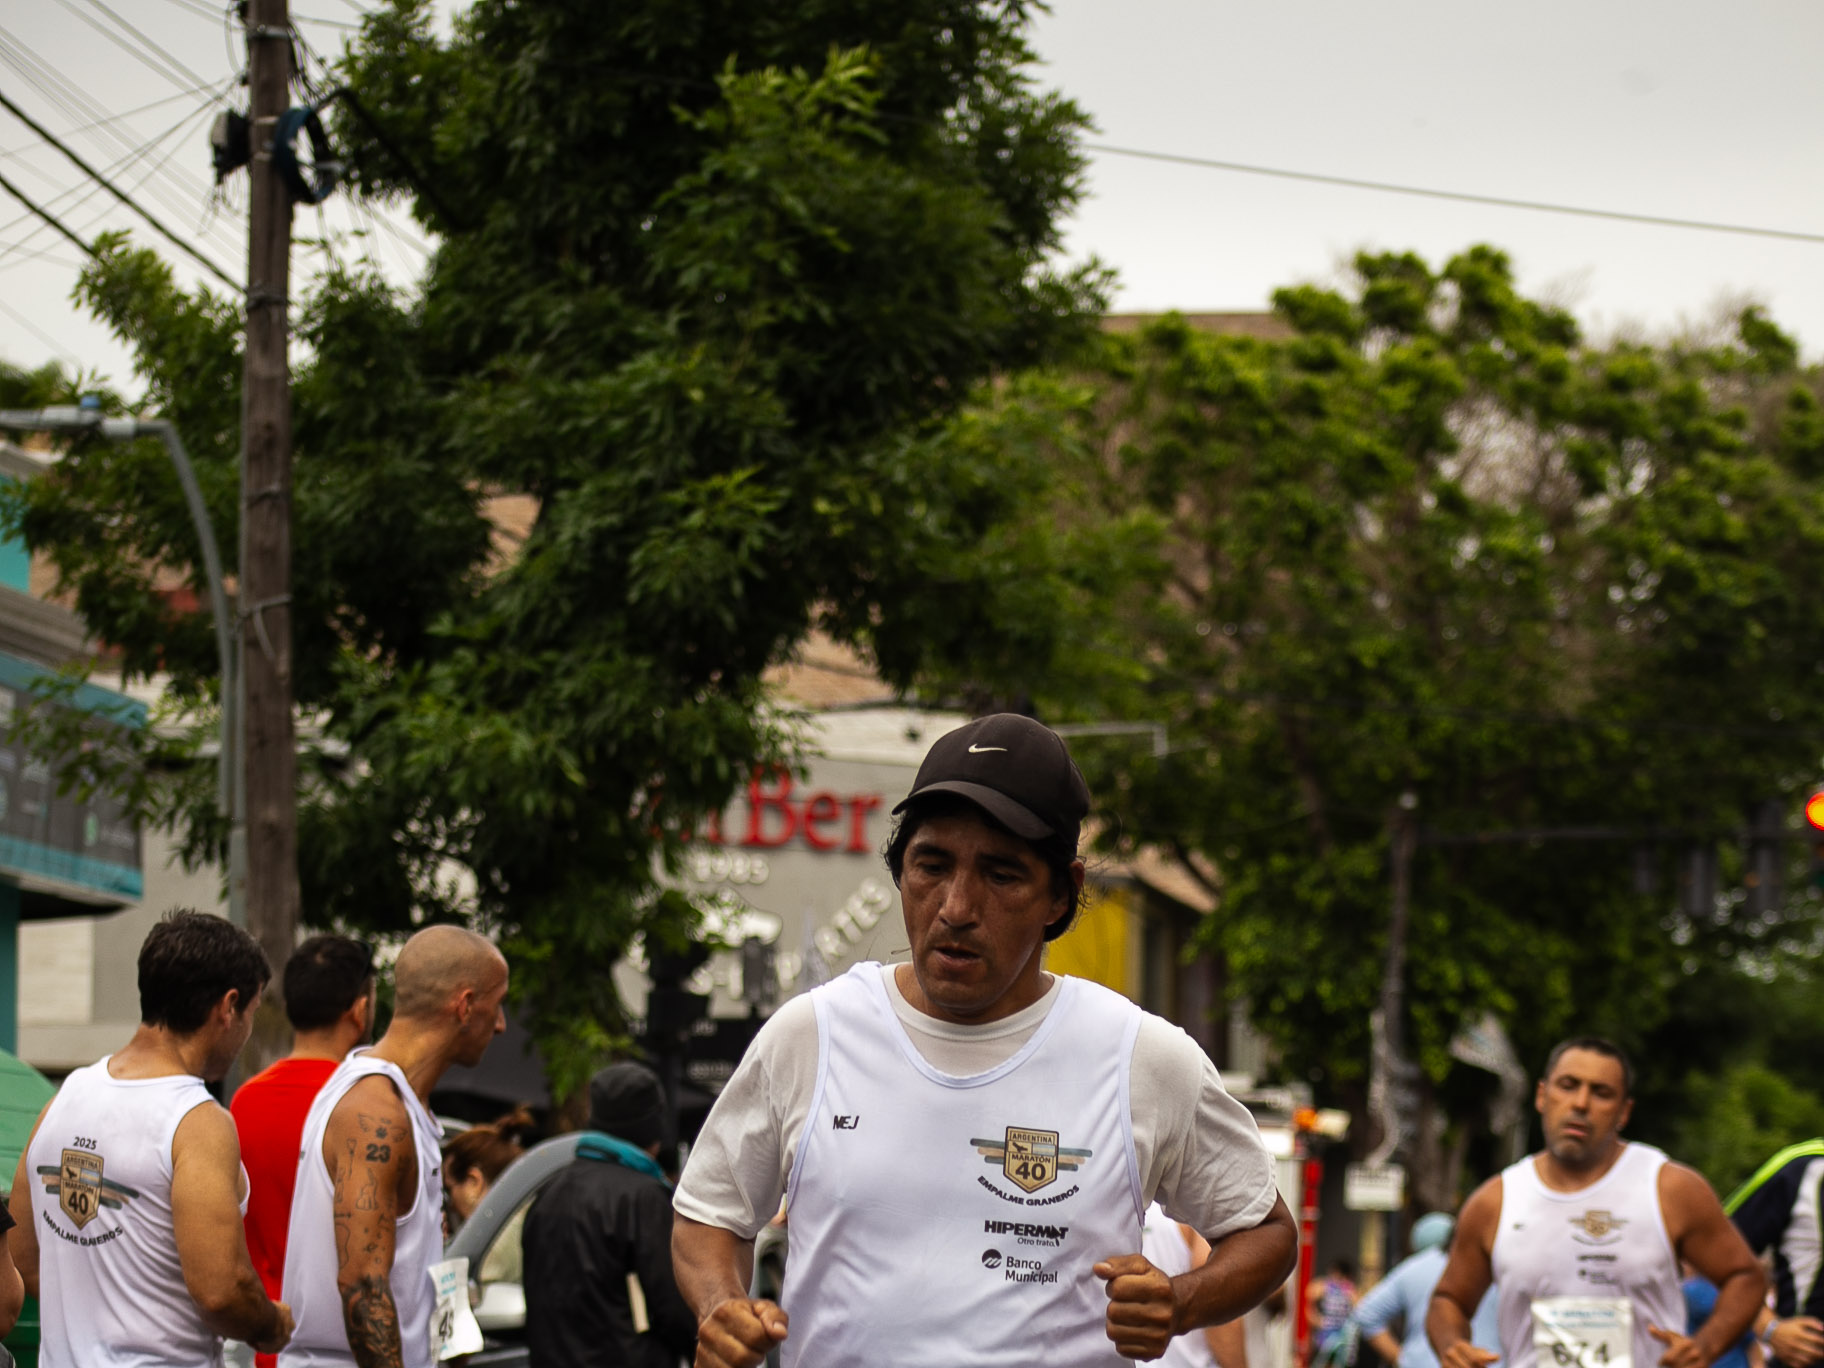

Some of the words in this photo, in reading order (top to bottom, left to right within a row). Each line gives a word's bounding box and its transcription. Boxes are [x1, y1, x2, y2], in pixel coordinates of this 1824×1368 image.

[73, 1136, 97, 1150] 2025
[1012, 1132, 1053, 1143] ARGENTINA
[365, 1143, 391, 1163] 23
[1015, 1161, 1046, 1181] 40
[977, 1175, 1025, 1205] EMPALME
[1026, 1184, 1080, 1206] GRANEROS
[68, 1191, 88, 1215] 40
[43, 1209, 79, 1244] EMPALME
[1017, 1237, 1035, 1246] Otro
[1006, 1255, 1042, 1270] Banco
[1005, 1269, 1058, 1285] Municipal
